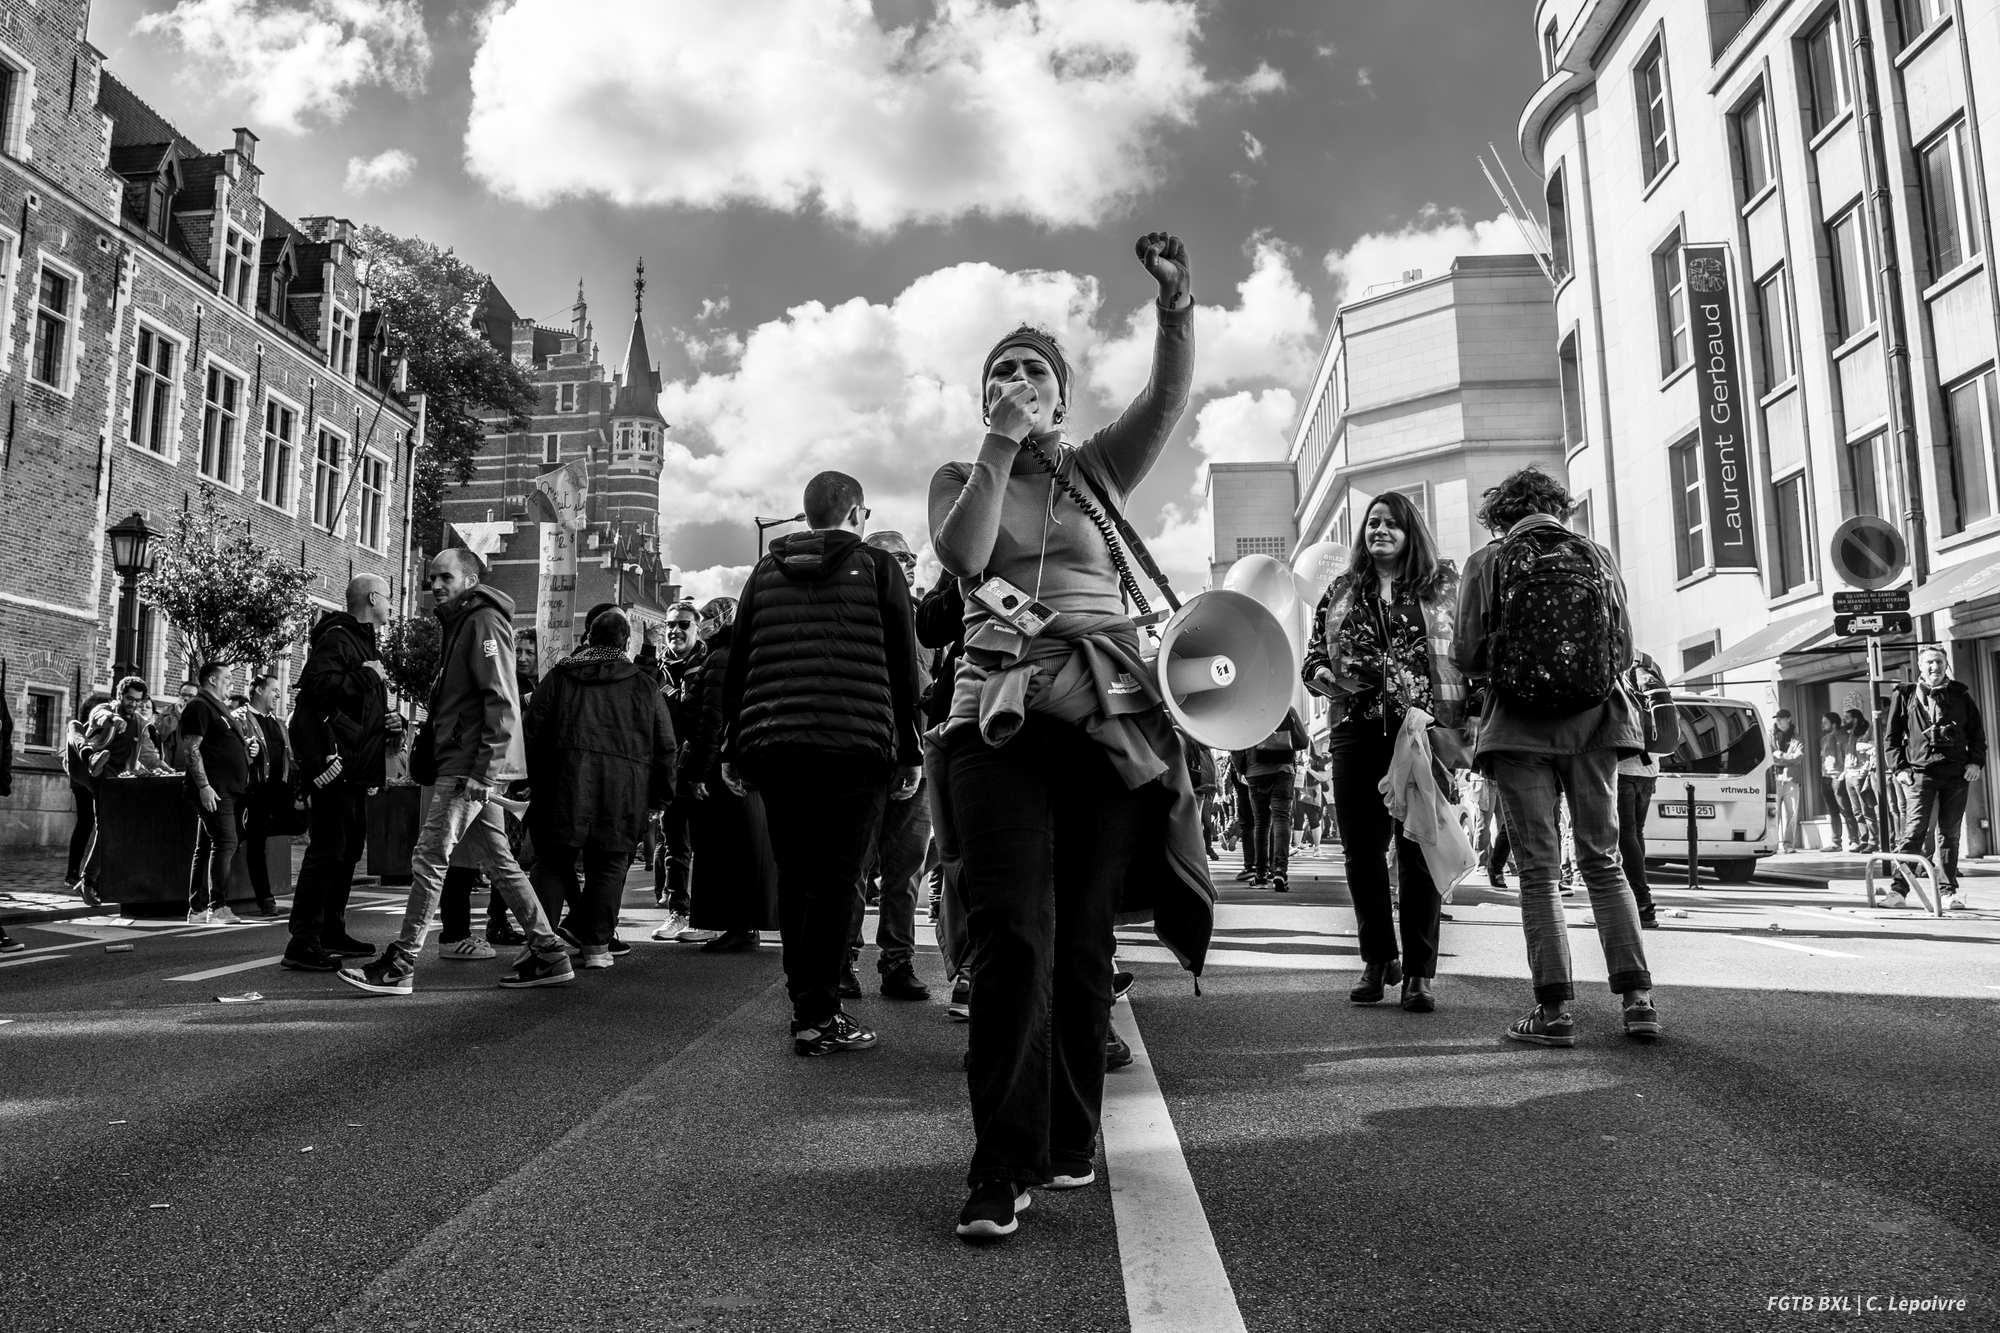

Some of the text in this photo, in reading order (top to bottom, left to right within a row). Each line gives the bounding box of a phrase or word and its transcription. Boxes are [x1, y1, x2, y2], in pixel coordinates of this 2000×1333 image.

[1700, 303, 1744, 546] Laurent Gerbaud
[1323, 554, 1343, 562] GELEZ
[1331, 561, 1346, 569] PRIX
[312, 758, 343, 789] PUMA
[1720, 785, 1761, 795] vrtnws.be
